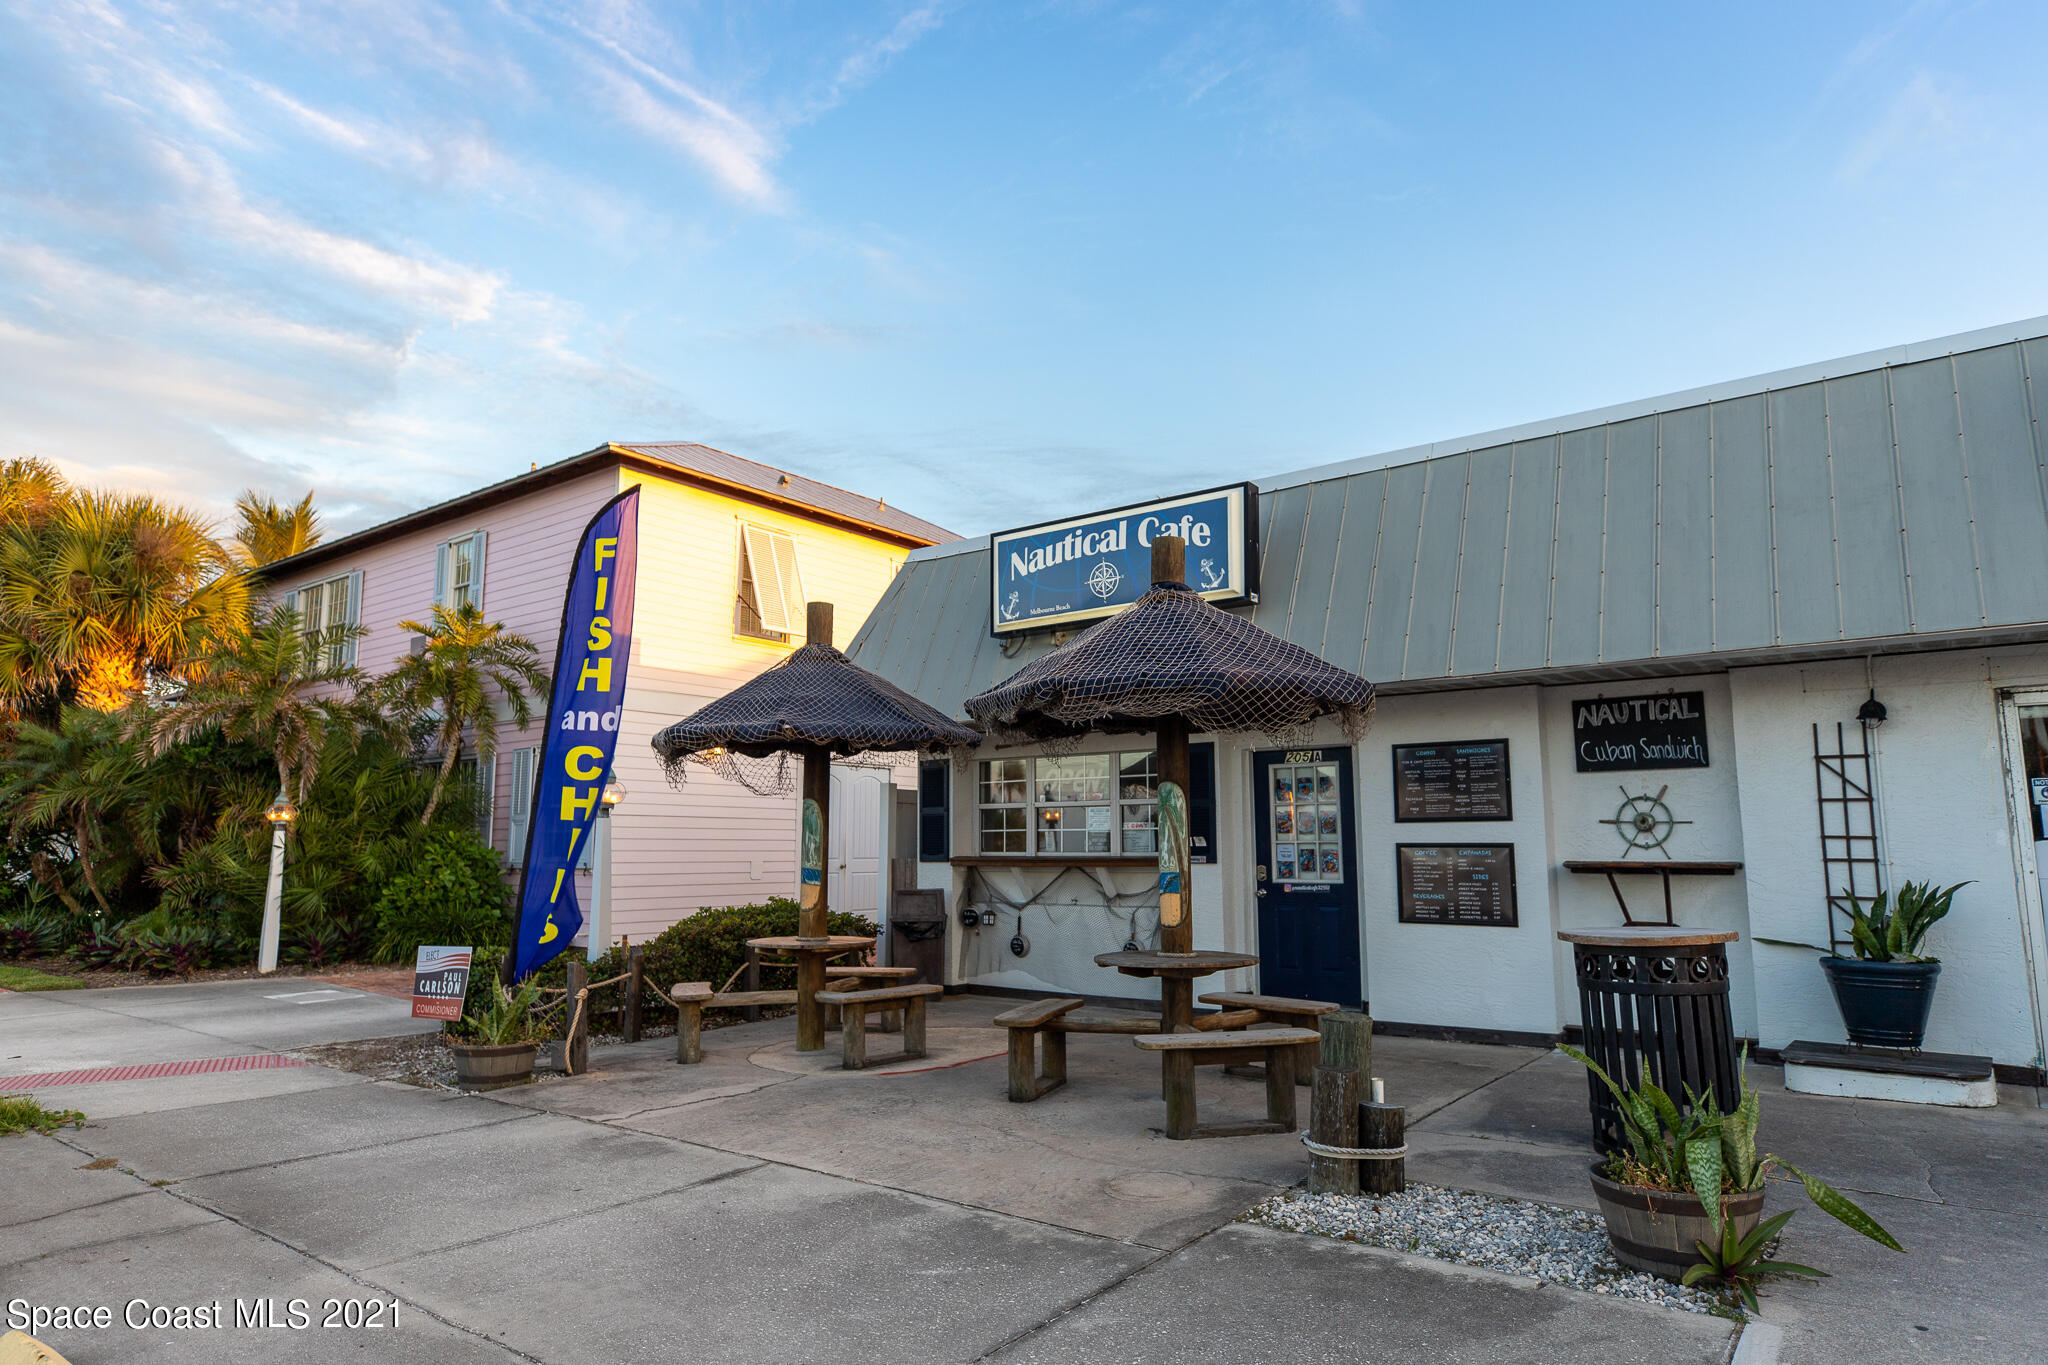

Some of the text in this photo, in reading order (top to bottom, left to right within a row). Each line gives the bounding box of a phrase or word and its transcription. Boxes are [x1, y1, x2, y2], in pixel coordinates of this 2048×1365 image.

[1010, 514, 1211, 582] Nautical Cafe
[577, 537, 618, 692] FISH
[1055, 602, 1071, 611] Beach
[561, 705, 622, 731] and
[1577, 698, 1699, 729] NAUTICAL
[1580, 734, 1707, 764] Cuban Sandwich
[425, 949, 440, 961] ELECT
[419, 979, 461, 994] CARLSON
[443, 971, 462, 982] PAUL
